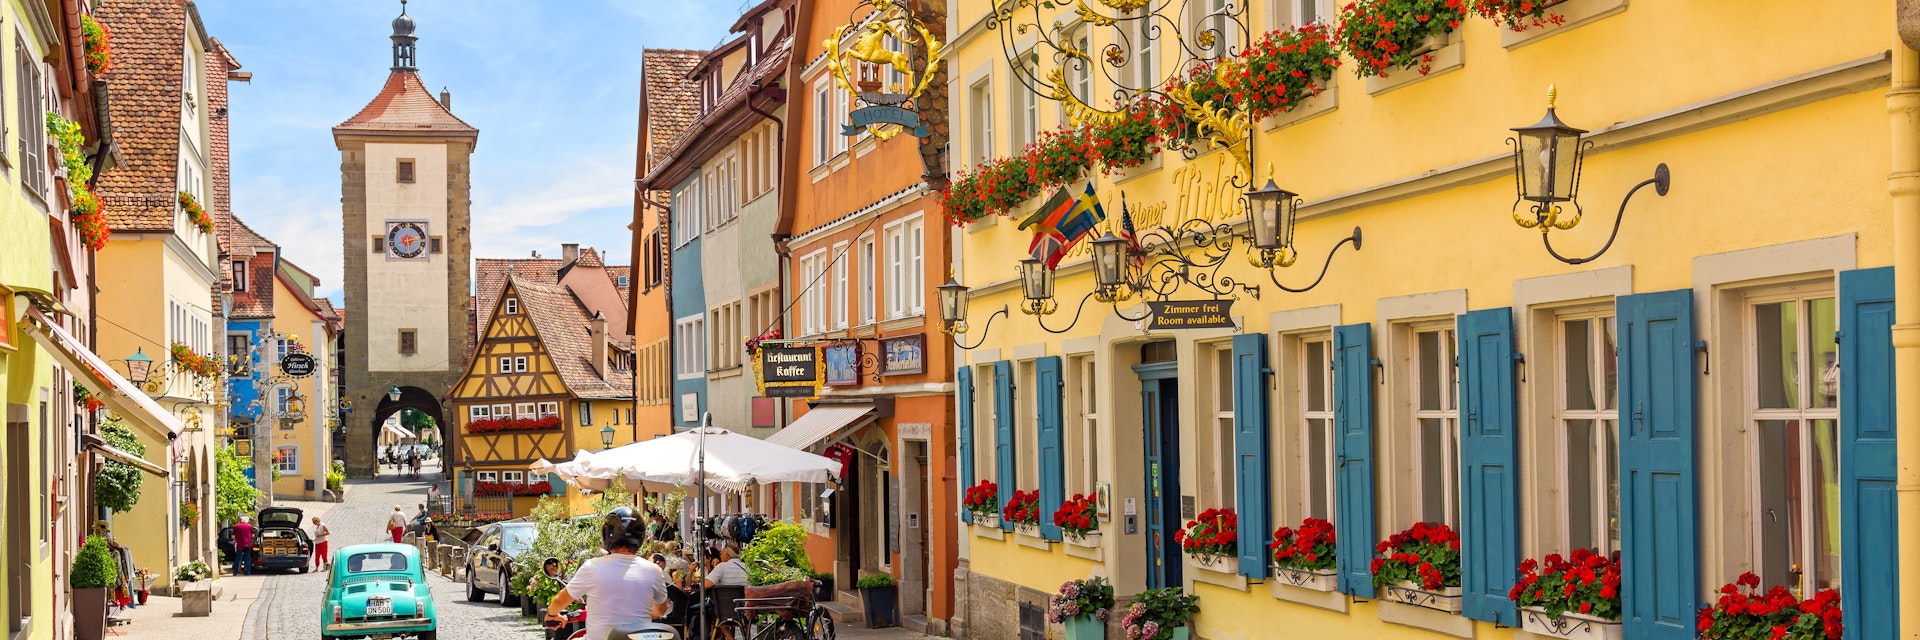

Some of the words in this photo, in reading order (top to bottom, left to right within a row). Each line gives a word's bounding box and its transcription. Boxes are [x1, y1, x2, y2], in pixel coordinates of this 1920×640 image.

[863, 108, 906, 122] HOTEL
[1164, 304, 1200, 314] Zimmer
[1203, 303, 1219, 313] frei
[1157, 316, 1184, 326] Room
[1186, 315, 1226, 325] available
[767, 351, 812, 364] Restaurant
[776, 365, 805, 377] Kaffee
